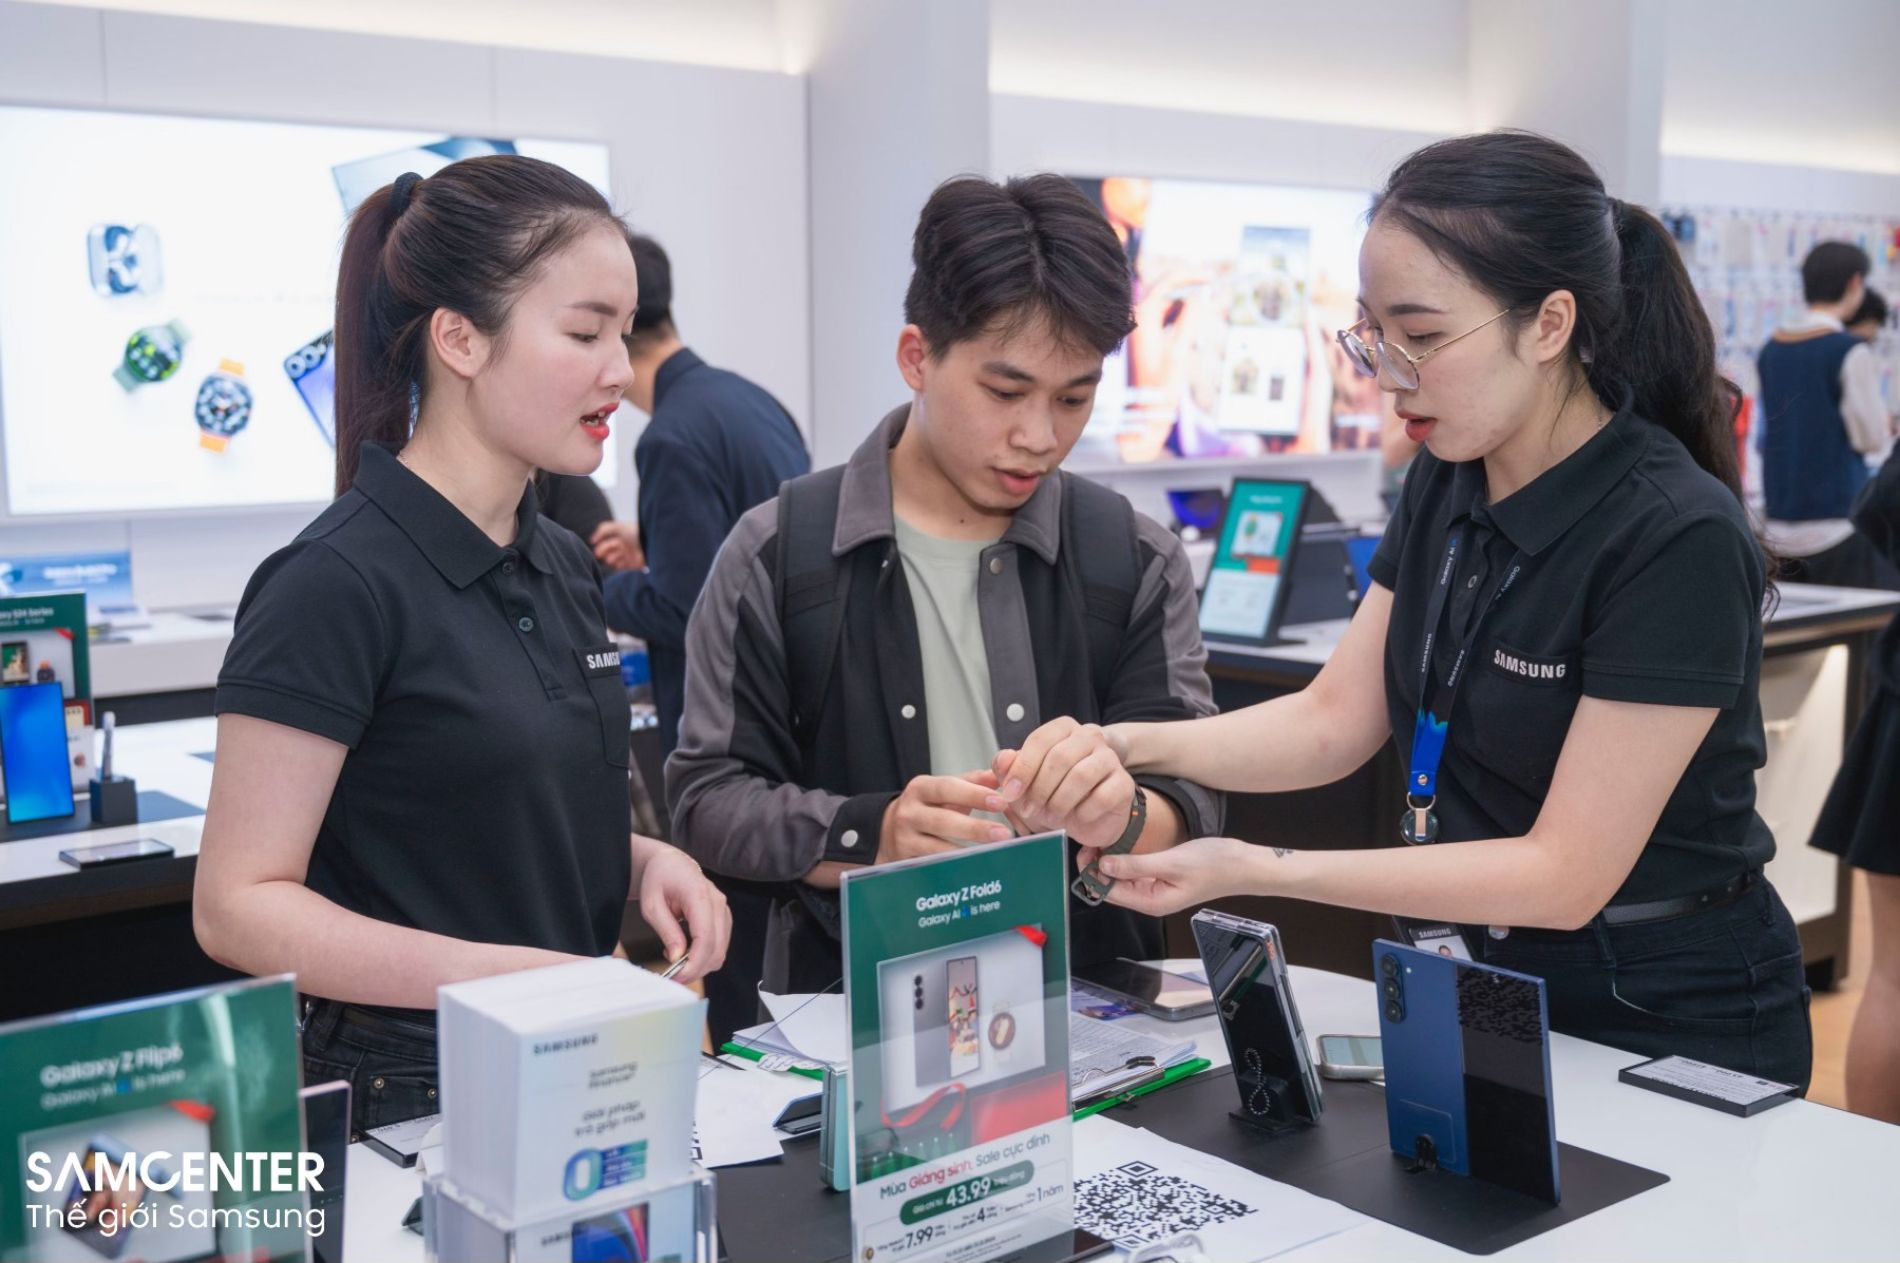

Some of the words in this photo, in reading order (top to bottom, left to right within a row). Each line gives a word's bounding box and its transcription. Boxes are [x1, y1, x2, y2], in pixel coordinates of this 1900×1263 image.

[1494, 649, 1566, 679] SAMSUNG
[916, 893, 960, 911] Galaxy
[961, 887, 969, 901] Z
[970, 880, 1002, 899] Fold6
[918, 912, 952, 928] Galaxy
[970, 905, 978, 916] is
[979, 901, 1001, 913] here
[1418, 928, 1451, 938] SAMSUNG
[534, 1034, 599, 1055] SAMSUNG
[40, 1058, 119, 1088] Galaxy
[120, 1051, 133, 1072] Z
[135, 1045, 184, 1070] Flip6
[40, 1088, 99, 1111] Galaxy
[147, 1069, 186, 1086] here
[909, 1169, 946, 1188] Giáng
[976, 1150, 1000, 1167] Sale
[947, 1176, 991, 1206] 43.99
[977, 1207, 986, 1222] 4
[906, 1226, 933, 1249] 7.99
